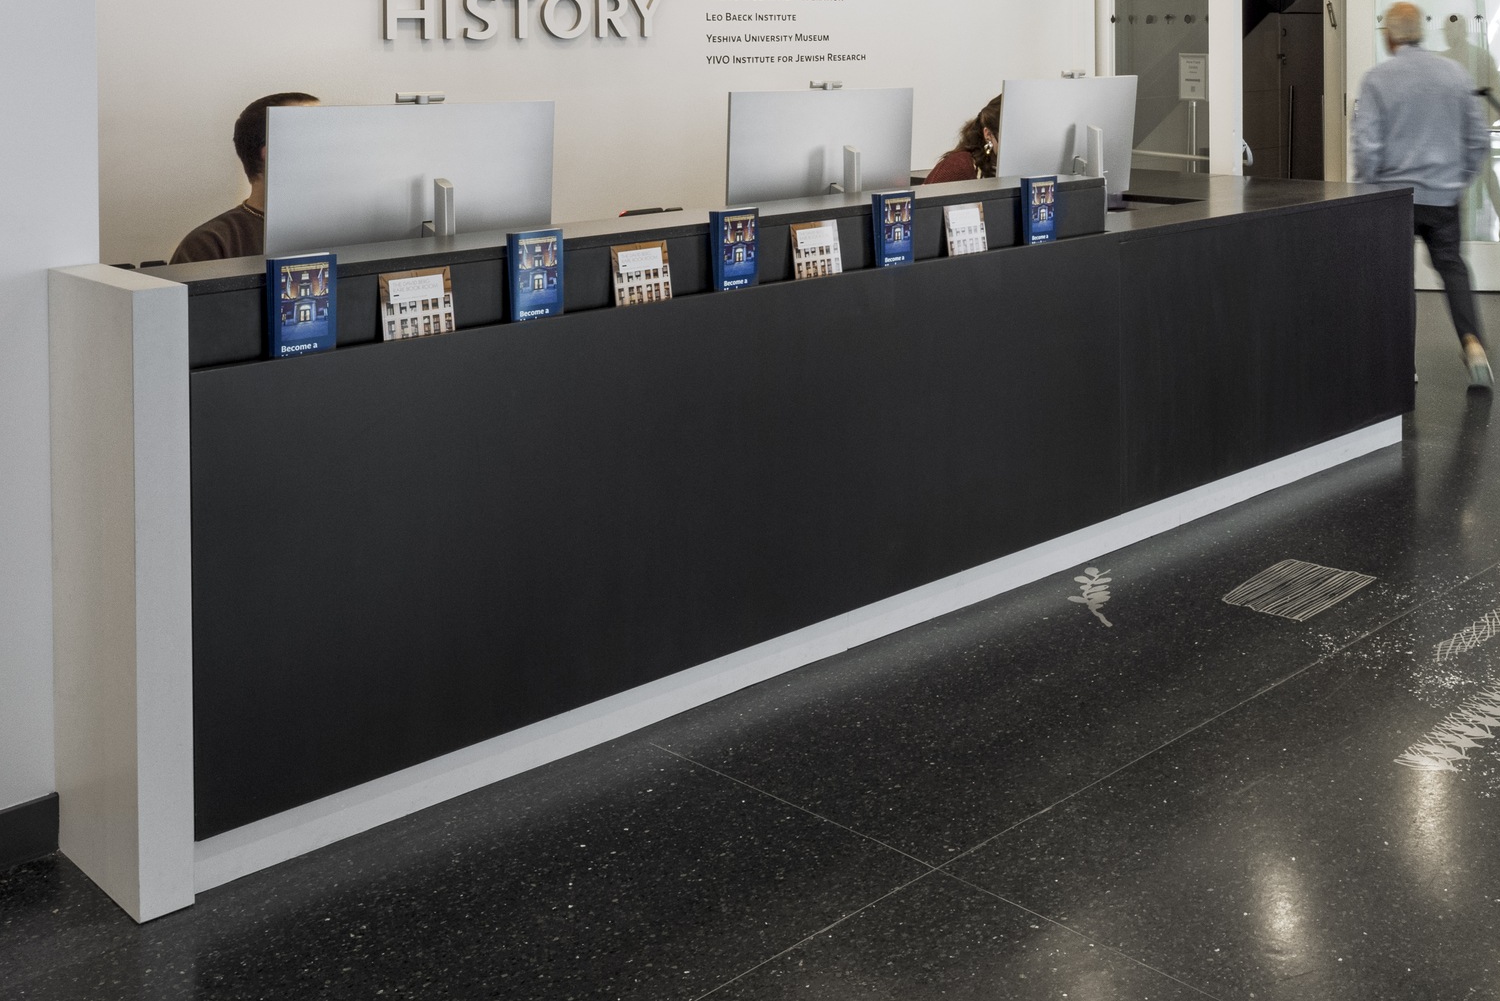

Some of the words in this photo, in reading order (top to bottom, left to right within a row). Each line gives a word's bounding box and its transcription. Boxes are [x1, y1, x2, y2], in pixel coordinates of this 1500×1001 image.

[706, 55, 730, 64] YIVO
[520, 309, 544, 317] Become
[281, 343, 312, 353] Become
